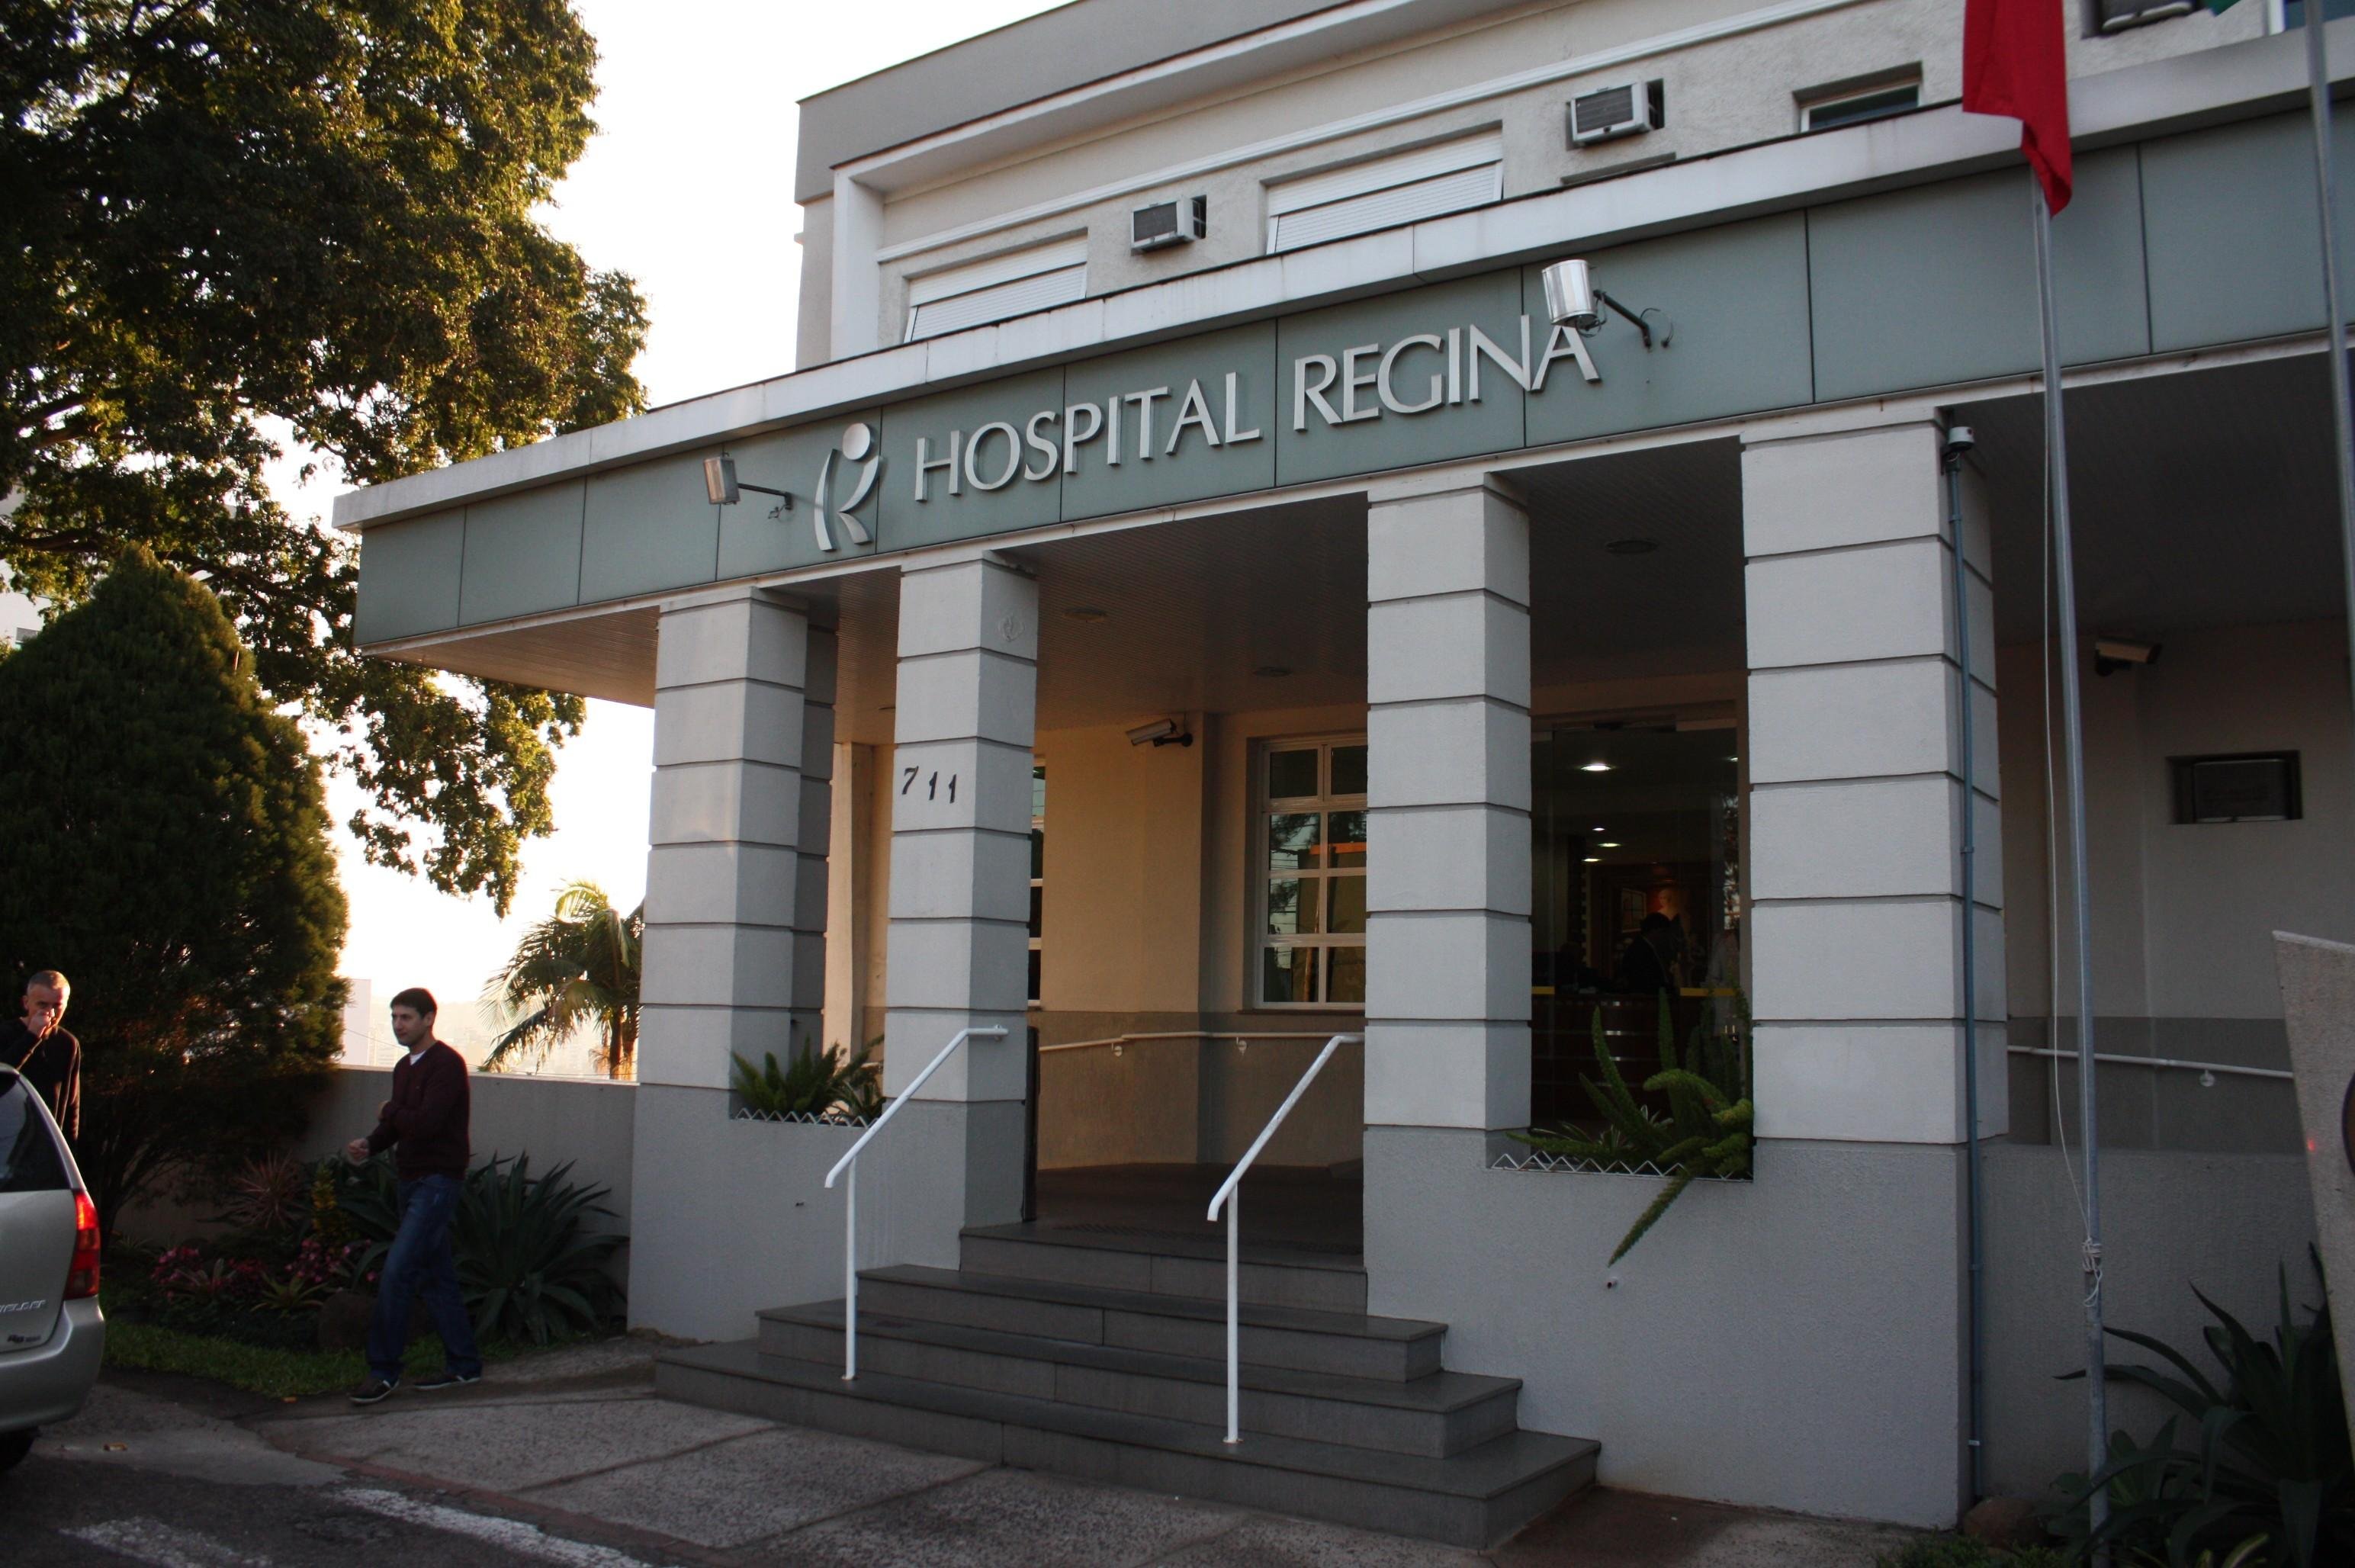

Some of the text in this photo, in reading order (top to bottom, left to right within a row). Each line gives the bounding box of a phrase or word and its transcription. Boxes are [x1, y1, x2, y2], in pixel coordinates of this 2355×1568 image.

[915, 315, 1601, 503] HOSPITAL REGINA
[901, 766, 956, 804] 711
